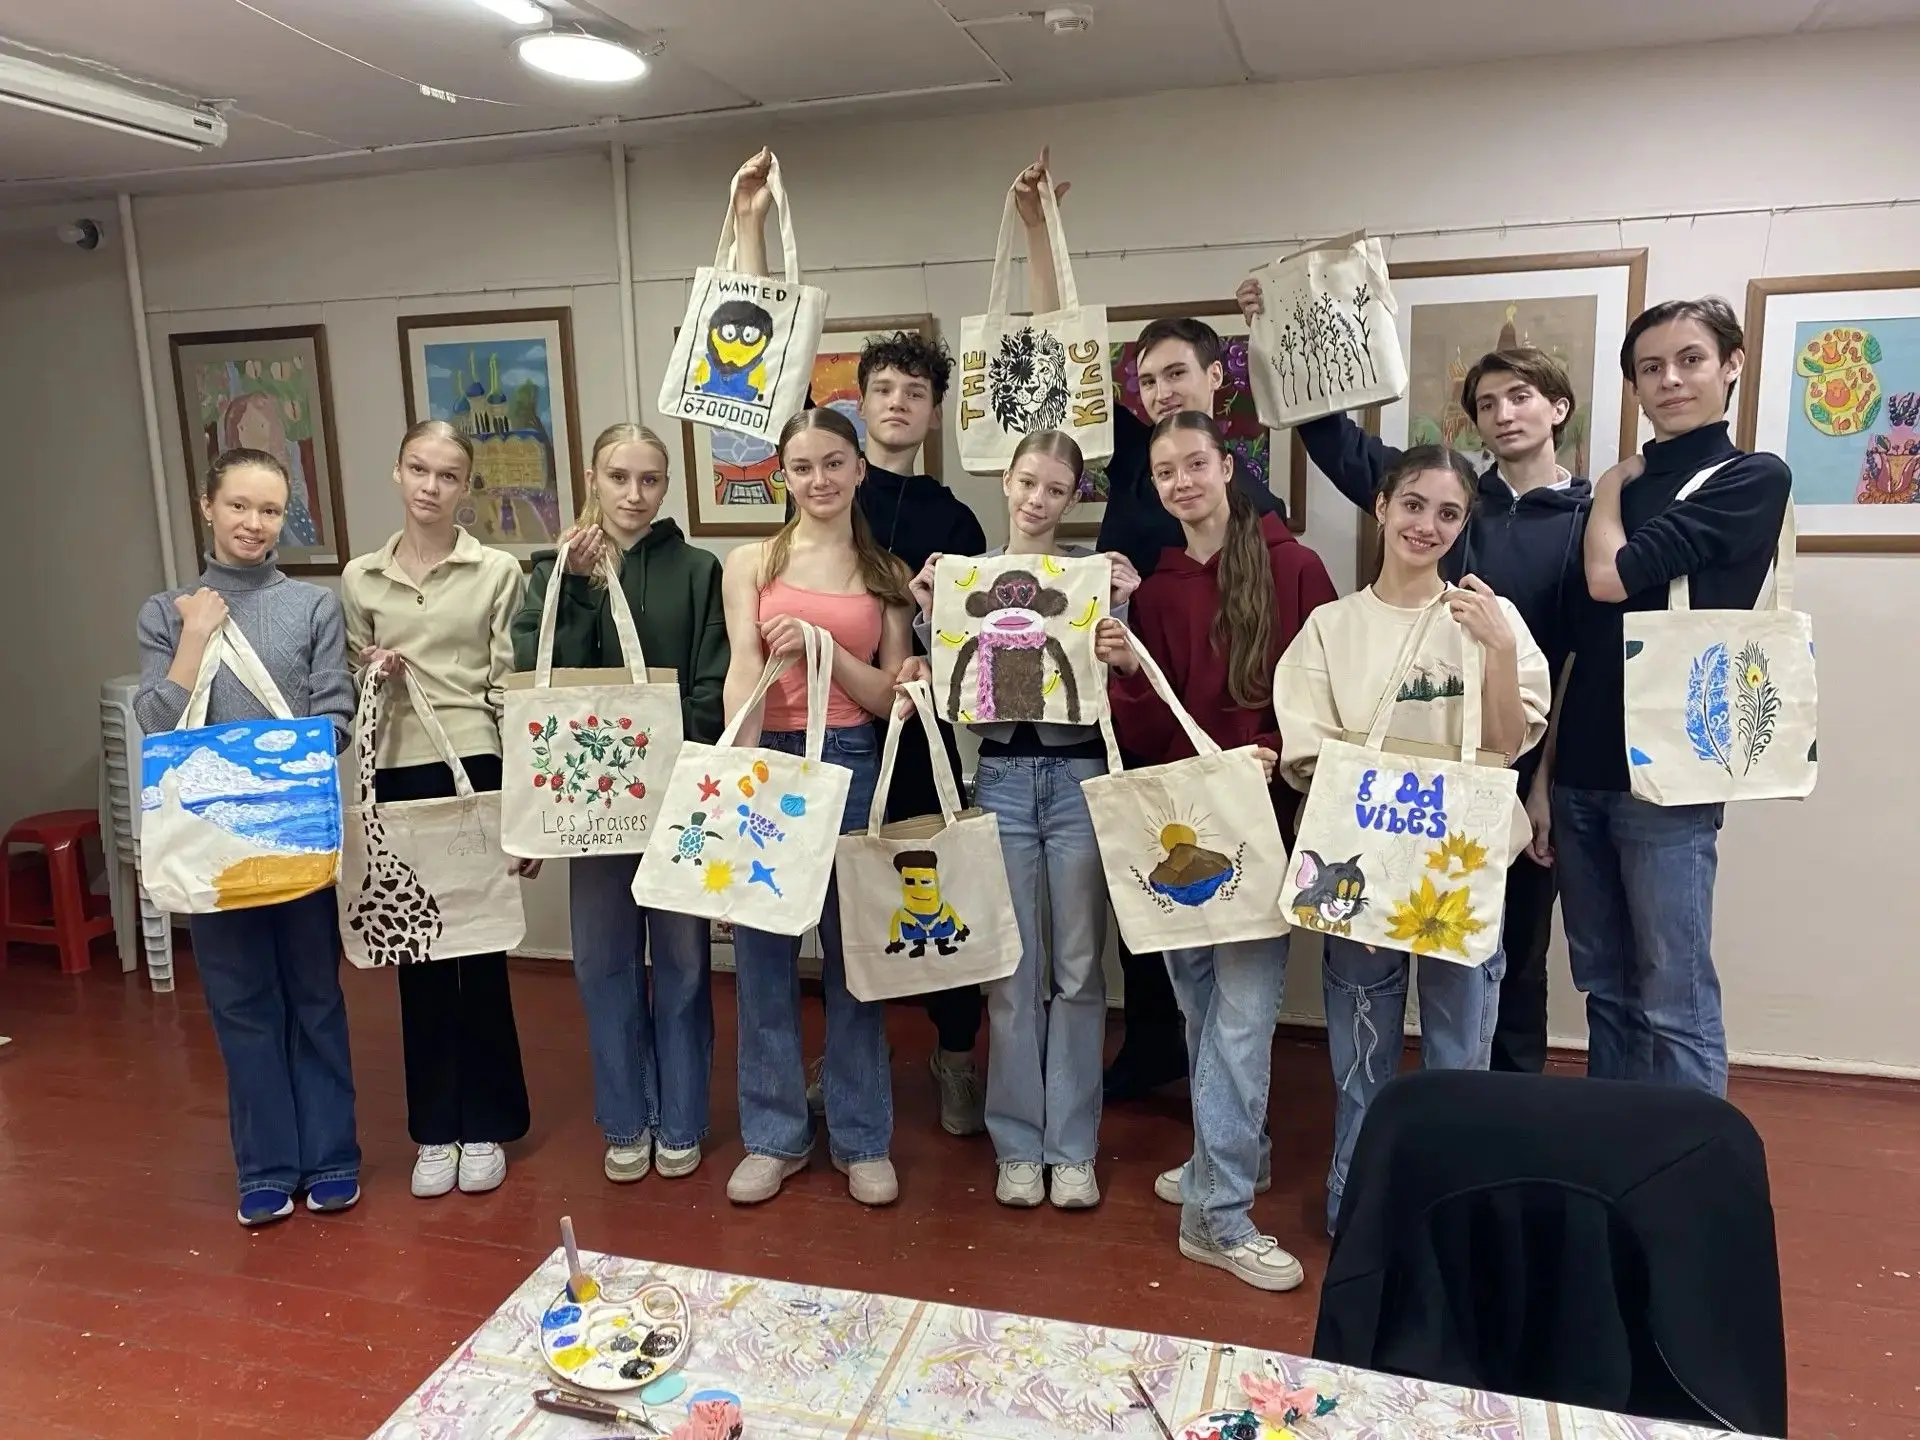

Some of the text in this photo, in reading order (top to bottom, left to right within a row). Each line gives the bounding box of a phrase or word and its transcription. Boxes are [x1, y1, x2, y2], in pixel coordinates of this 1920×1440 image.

[718, 279, 787, 302] WANTED
[961, 350, 986, 430] THE
[683, 397, 764, 429] 6700000
[543, 809, 648, 834] Les fraises
[1356, 804, 1448, 839] vibes
[561, 833, 623, 846] FRAGARIA
